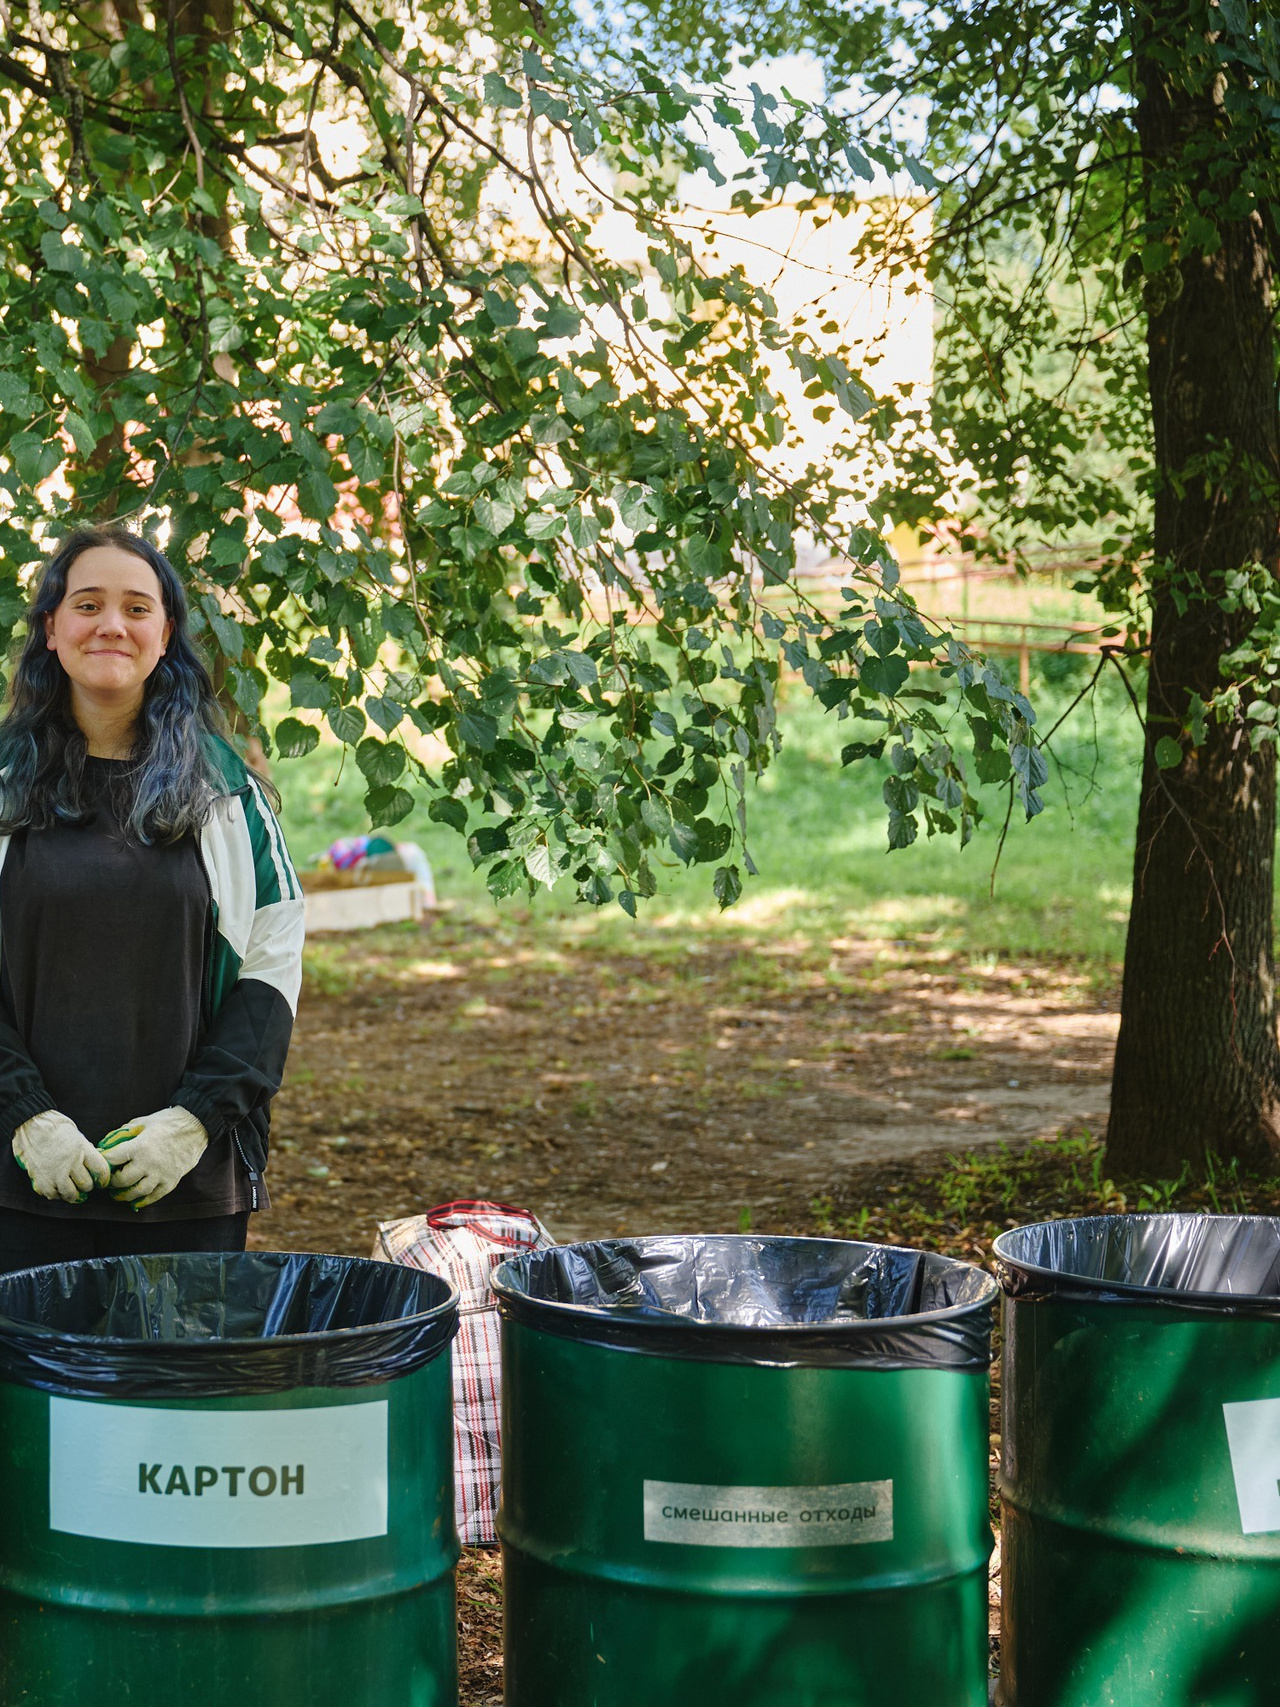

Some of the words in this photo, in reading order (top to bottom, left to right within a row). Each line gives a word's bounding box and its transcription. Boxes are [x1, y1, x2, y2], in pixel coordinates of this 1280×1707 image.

[138, 1462, 305, 1497] КАРТОН
[661, 1506, 789, 1523] смешанные
[799, 1505, 876, 1525] отходы
